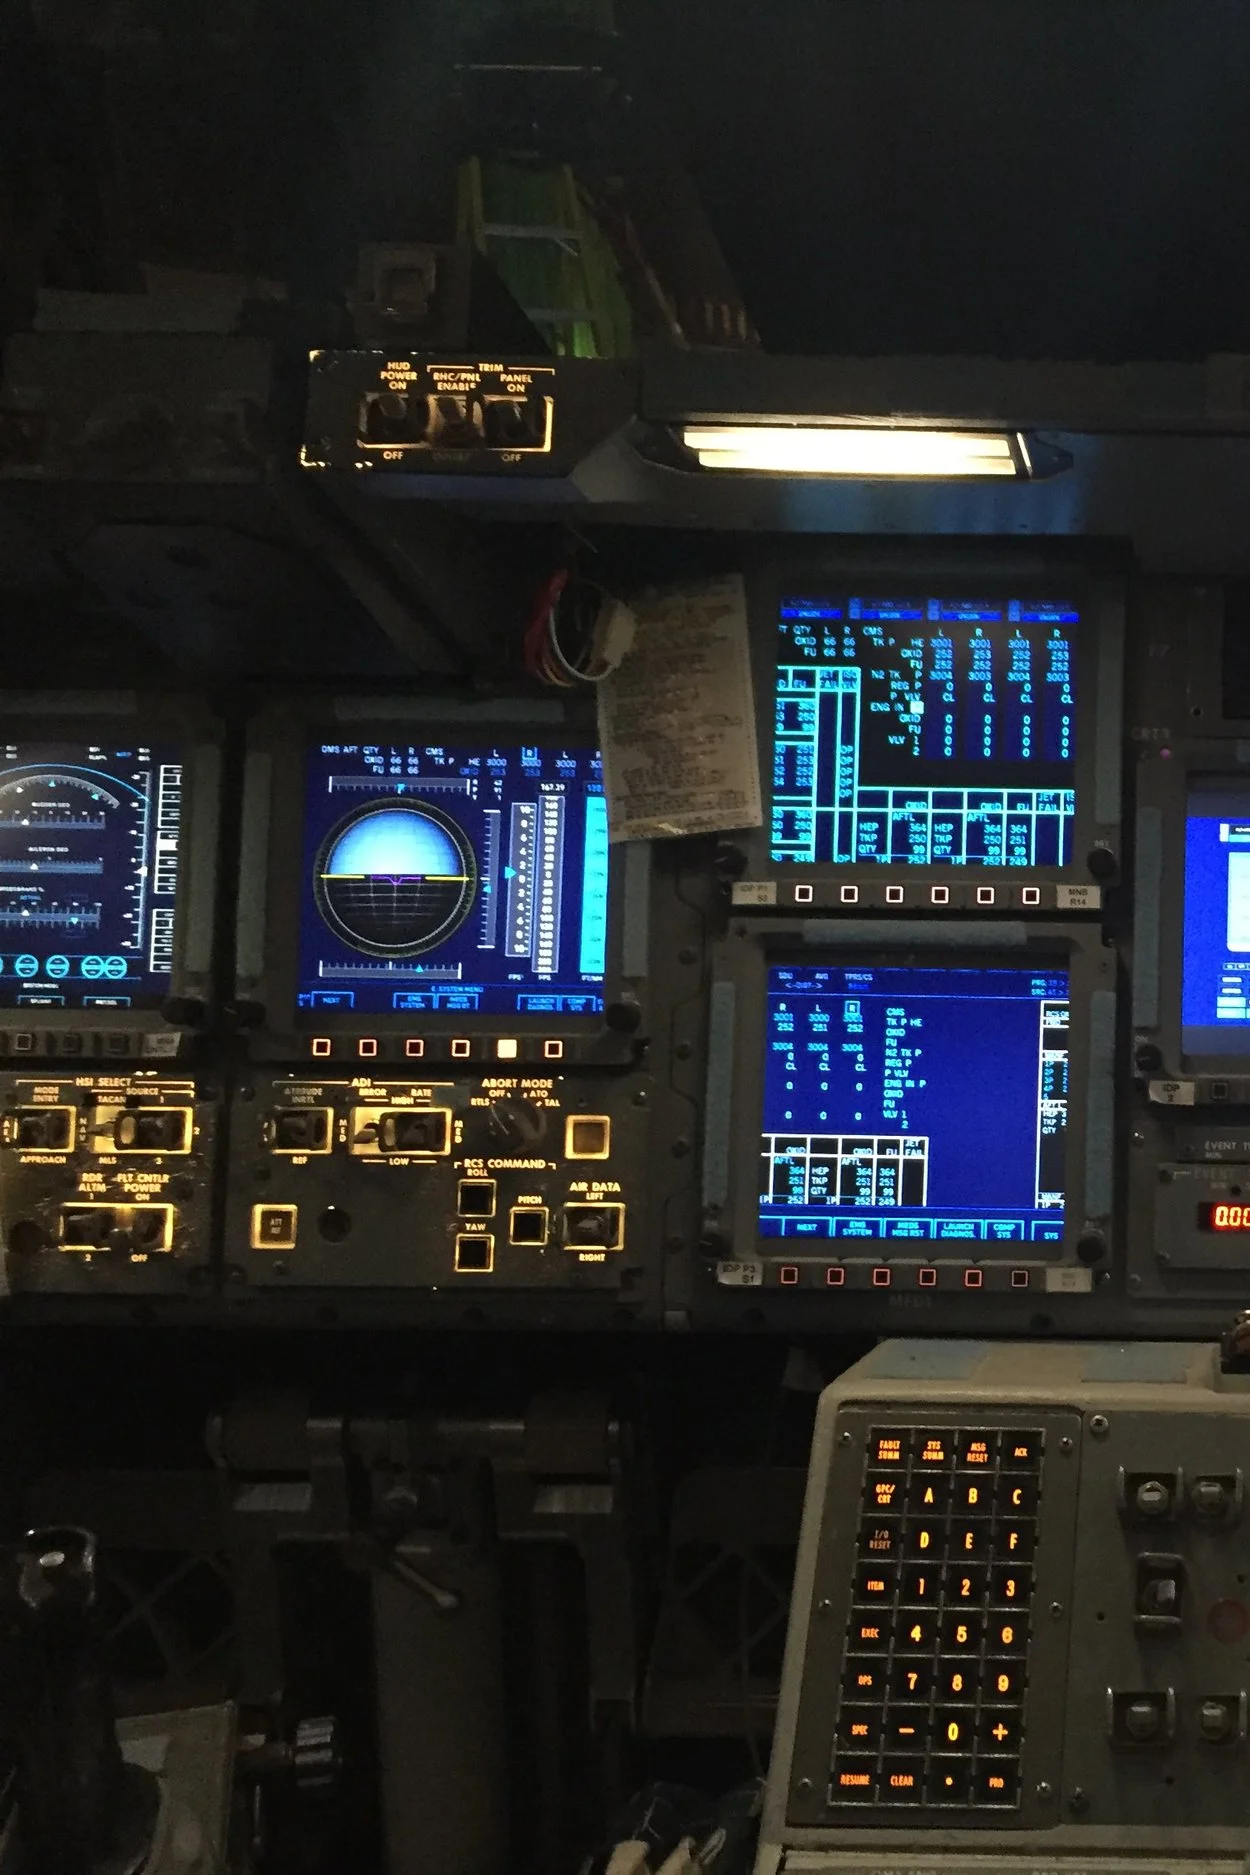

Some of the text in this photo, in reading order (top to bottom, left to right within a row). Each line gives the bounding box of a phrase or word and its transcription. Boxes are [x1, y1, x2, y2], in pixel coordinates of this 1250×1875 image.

[387, 362, 410, 370] HUD
[479, 364, 504, 372] TRIM
[380, 371, 418, 380] POWER
[432, 373, 481, 381] RHC/PNL
[500, 374, 533, 382] PANEL
[388, 381, 407, 390] ON
[507, 384, 526, 392] ON
[383, 451, 403, 460] OFF
[501, 454, 522, 462] OFF
[792, 625, 811, 635] QTY
[824, 626, 831, 635] L
[975, 628, 983, 638] R
[99, 1077, 131, 1086] SELECT
[352, 1078, 372, 1087] ADI
[482, 1079, 553, 1088] ABORT MODE
[488, 1089, 506, 1098] OFF
[529, 1090, 549, 1098] ATO
[470, 1098, 490, 1106] RTLS
[544, 1099, 560, 1107] TAL
[1204, 1141, 1237, 1151] EVENT
[389, 1158, 410, 1166] LOW
[464, 1159, 547, 1169] RCS COMMAND
[467, 1169, 488, 1177] ROLL
[124, 1183, 162, 1193] POWER
[569, 1182, 621, 1193] AIR DATA
[585, 1192, 604, 1200] LEFT
[465, 1222, 487, 1231] YAW
[578, 1253, 606, 1262] RIGHT
[924, 1487, 934, 1504] A
[968, 1488, 978, 1504] B
[1012, 1489, 1021, 1505] C
[919, 1531, 930, 1548] D
[965, 1532, 974, 1549] E
[1009, 1533, 1018, 1549] F
[919, 1578, 925, 1595] 1
[961, 1578, 971, 1596] 2
[1006, 1580, 1015, 1597] 3
[910, 1625, 922, 1641] 4
[956, 1625, 968, 1642] 5
[907, 1673, 918, 1691] 7
[948, 1722, 959, 1740] 0
